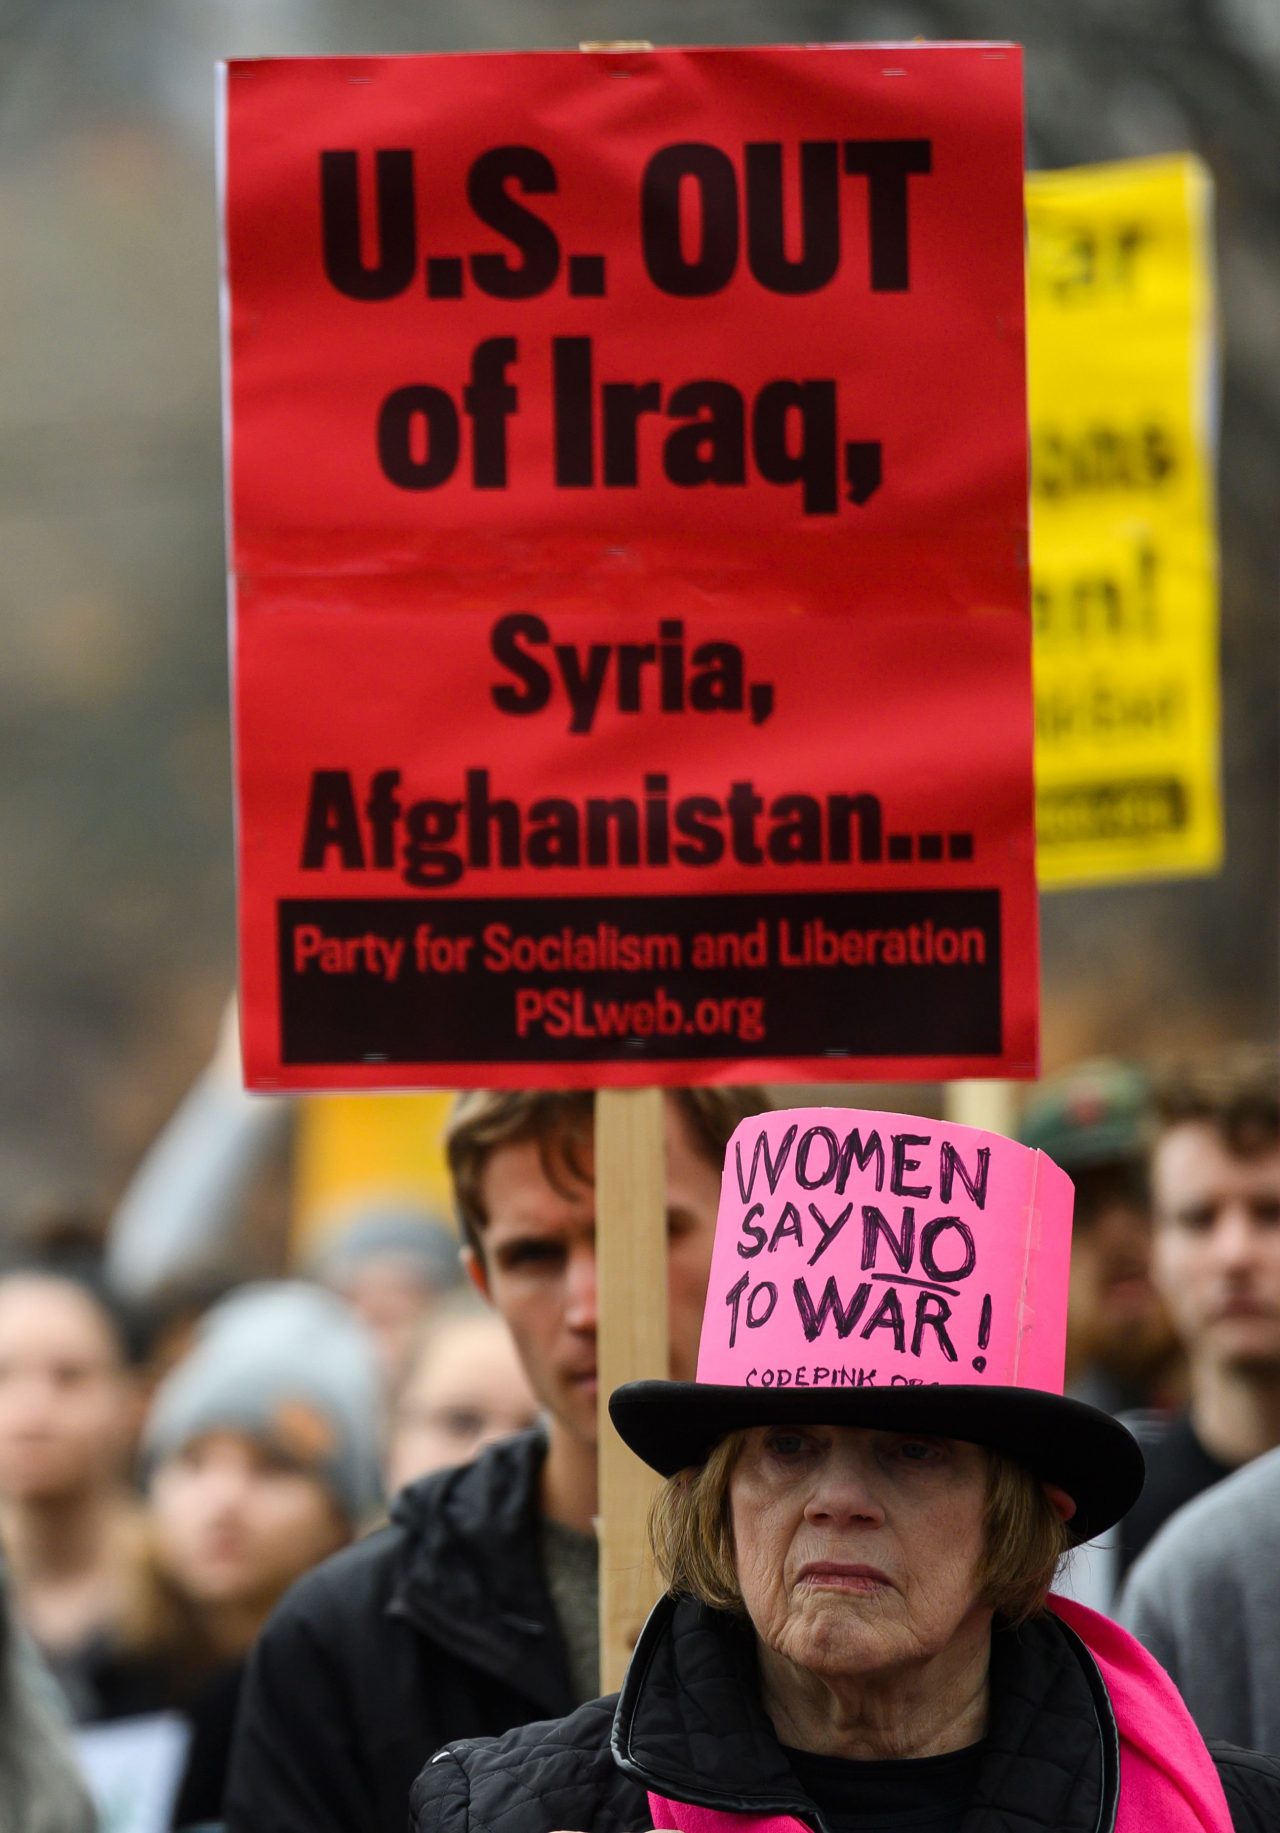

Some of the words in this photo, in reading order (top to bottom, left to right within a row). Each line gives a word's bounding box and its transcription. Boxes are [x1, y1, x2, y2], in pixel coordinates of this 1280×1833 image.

[321, 144, 607, 302] U.S.
[640, 138, 932, 297] OUT
[376, 336, 518, 492] of
[552, 336, 883, 515] Iraq,
[490, 613, 774, 735] Syria,
[299, 769, 973, 888] Afghanistan...
[293, 924, 404, 979] Party
[415, 925, 473, 972] for
[484, 920, 679, 972] Socialism
[692, 920, 767, 967] and
[779, 920, 986, 965] Liberation
[517, 988, 766, 1039] PSLweb.org
[736, 1124, 990, 1210] WOMEN
[737, 1201, 853, 1265] SAY
[860, 1206, 976, 1283] NO
[726, 1271, 778, 1348] TO
[792, 1275, 992, 1373] WAR!
